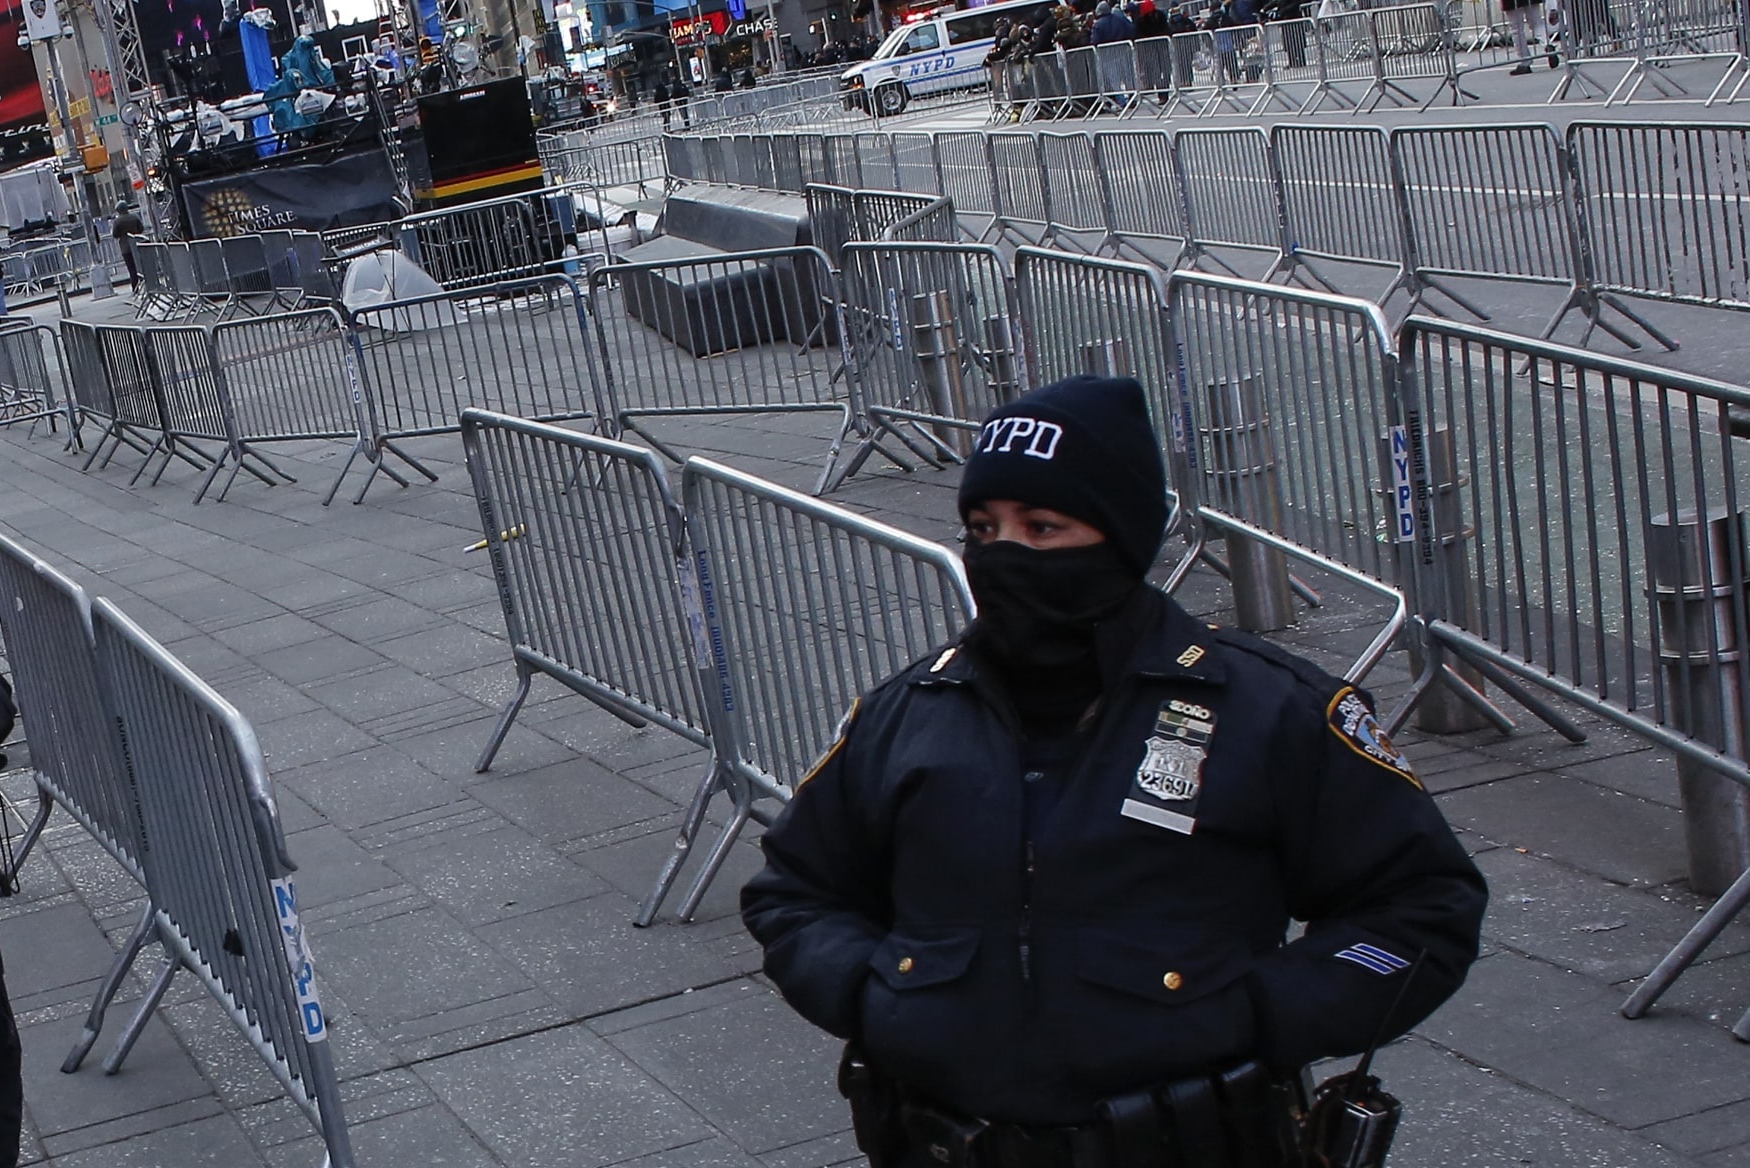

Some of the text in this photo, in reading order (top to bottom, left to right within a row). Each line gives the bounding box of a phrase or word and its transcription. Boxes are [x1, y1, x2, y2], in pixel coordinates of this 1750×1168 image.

[909, 57, 955, 76] NYPD
[227, 204, 296, 236] TIMES SQUARE
[975, 416, 1063, 460] YPD
[1392, 428, 1415, 537] NYPD
[703, 582, 715, 618] Fence
[1364, 744, 1392, 762] CITY
[1140, 771, 1192, 796] 23691
[274, 880, 324, 1036] NPD
